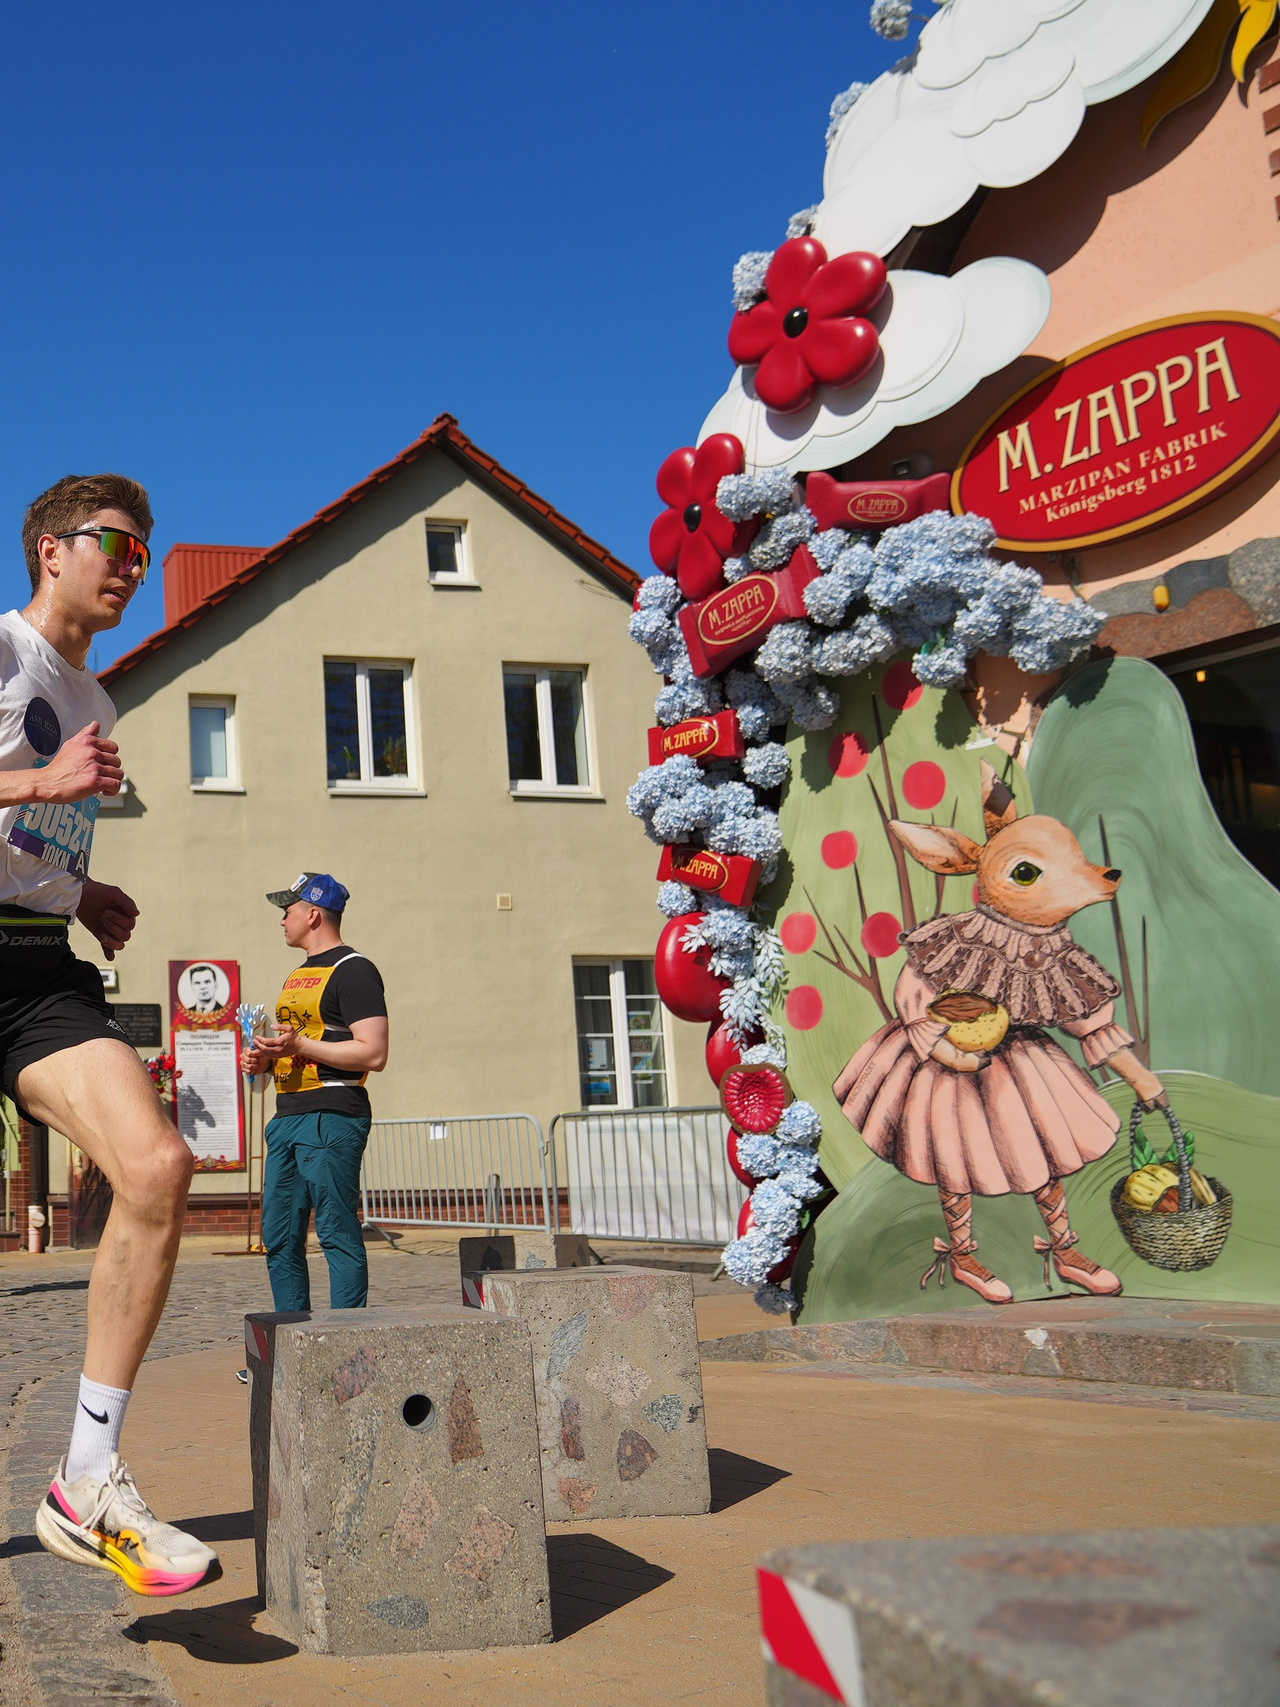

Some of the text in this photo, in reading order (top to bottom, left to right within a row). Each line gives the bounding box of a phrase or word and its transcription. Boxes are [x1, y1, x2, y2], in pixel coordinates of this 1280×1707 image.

[996, 336, 1241, 493] M. ZAPPA
[1018, 420, 1228, 514] MARZIPAN FABRIK
[1045, 454, 1198, 523] Königsberg 1812
[868, 498, 899, 511] ZAPPA
[708, 584, 765, 630] M. ZAPPA
[674, 728, 708, 749] ZAPPA
[23, 802, 92, 856] 50527
[40, 842, 71, 871] 10KM
[75, 851, 85, 875] A
[684, 856, 719, 880] ZAPPA
[9, 935, 64, 946] DEMIX
